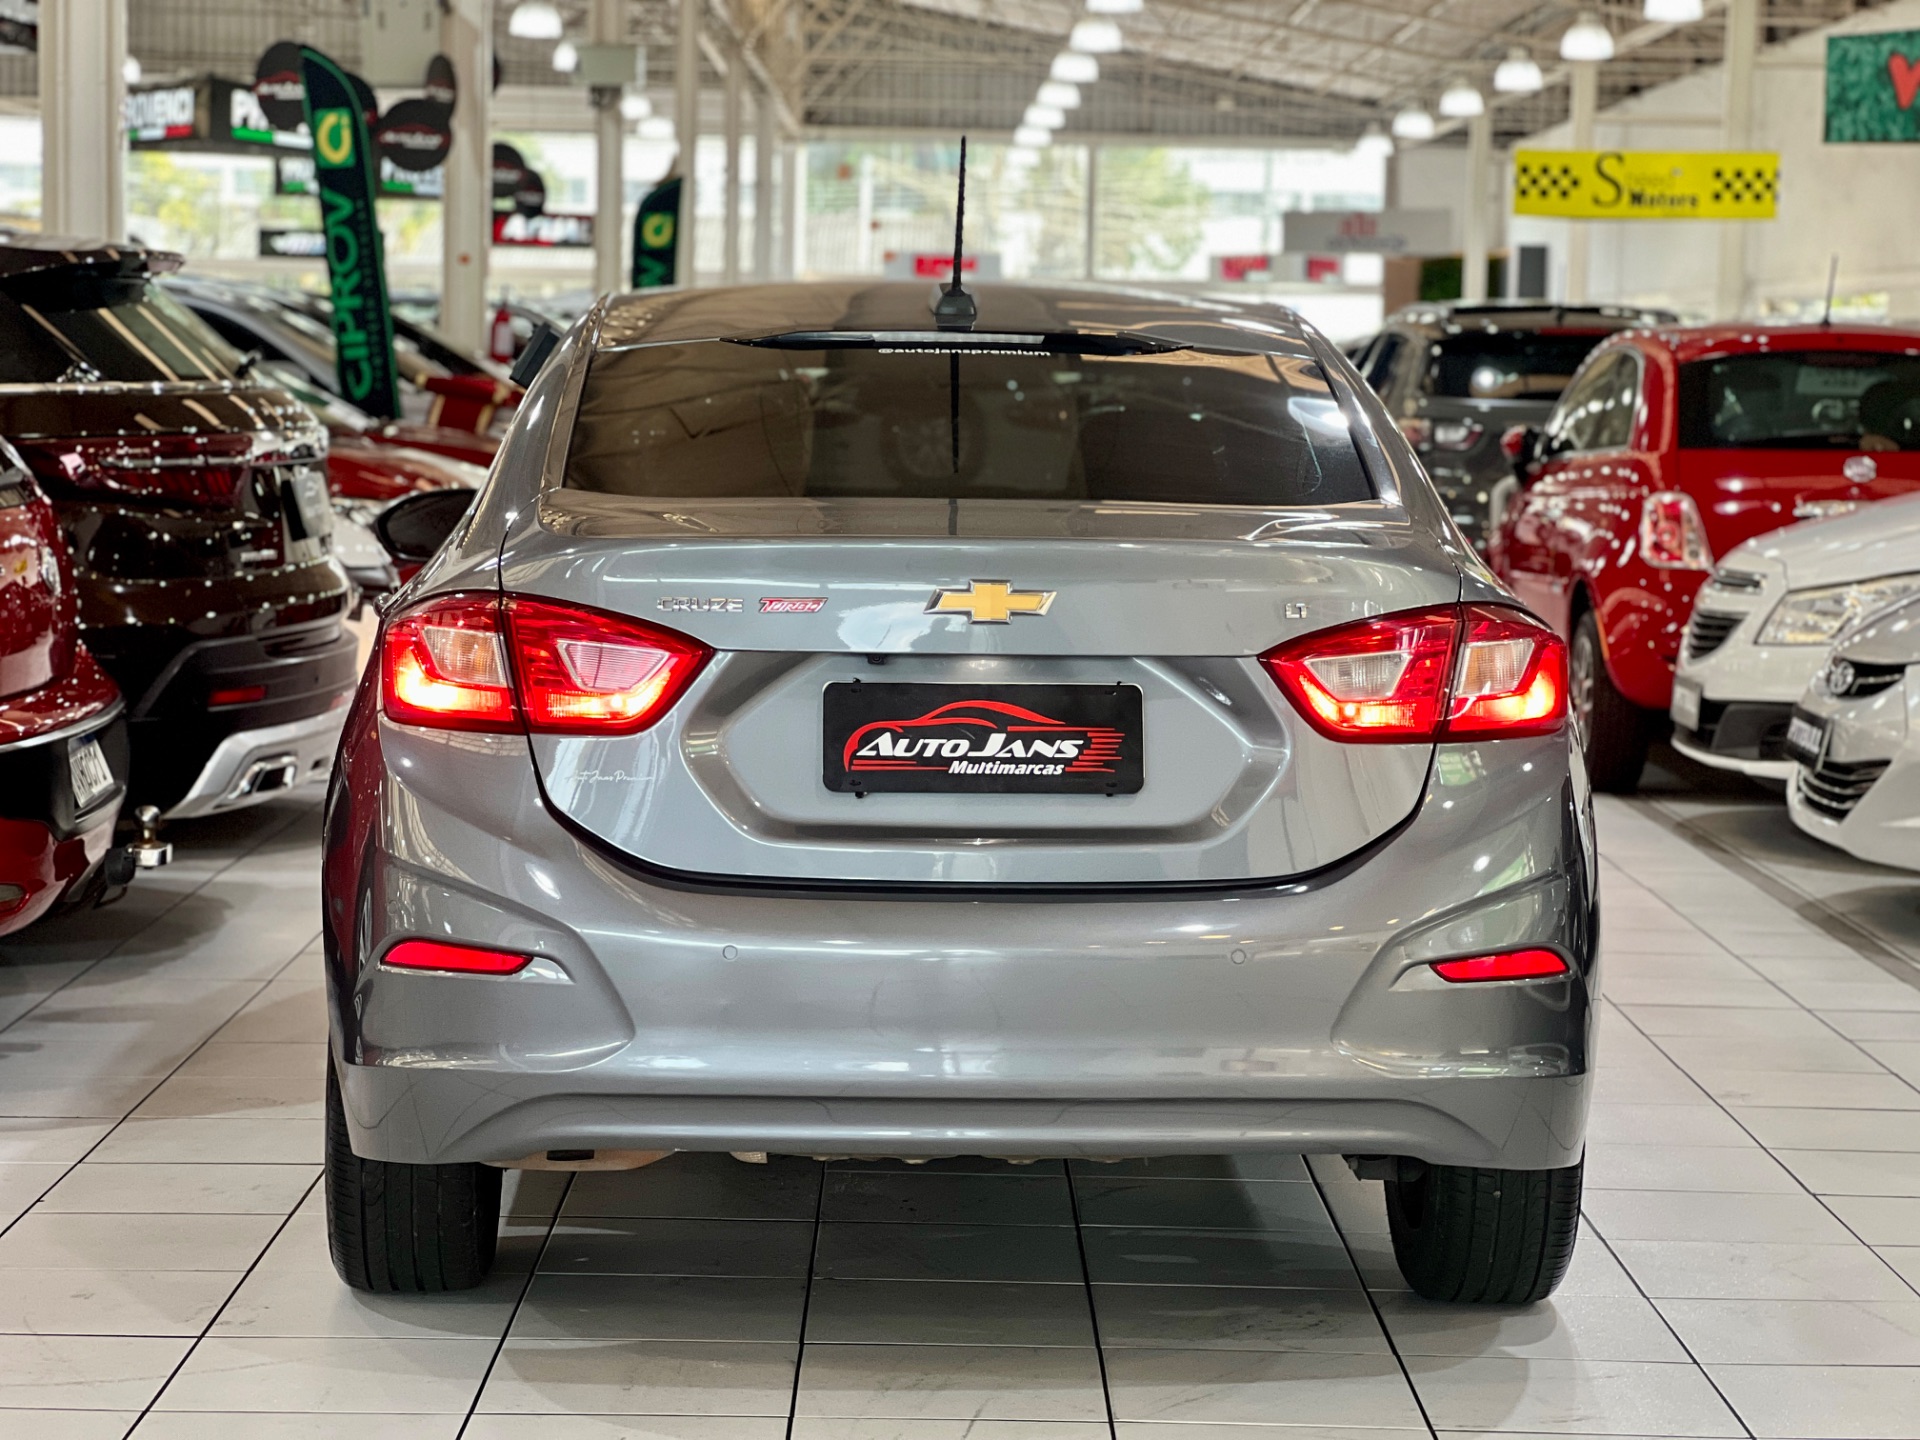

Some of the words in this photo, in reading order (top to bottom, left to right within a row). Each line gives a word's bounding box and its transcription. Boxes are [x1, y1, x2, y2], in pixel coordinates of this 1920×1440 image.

[321, 186, 373, 400] CIPROV
[656, 596, 744, 613] CRUZE
[759, 597, 829, 613] TURBO
[1285, 603, 1307, 619] LT
[856, 731, 970, 758] AUTO
[967, 732, 1084, 758] JANS
[948, 760, 1065, 775] Multimarcas
